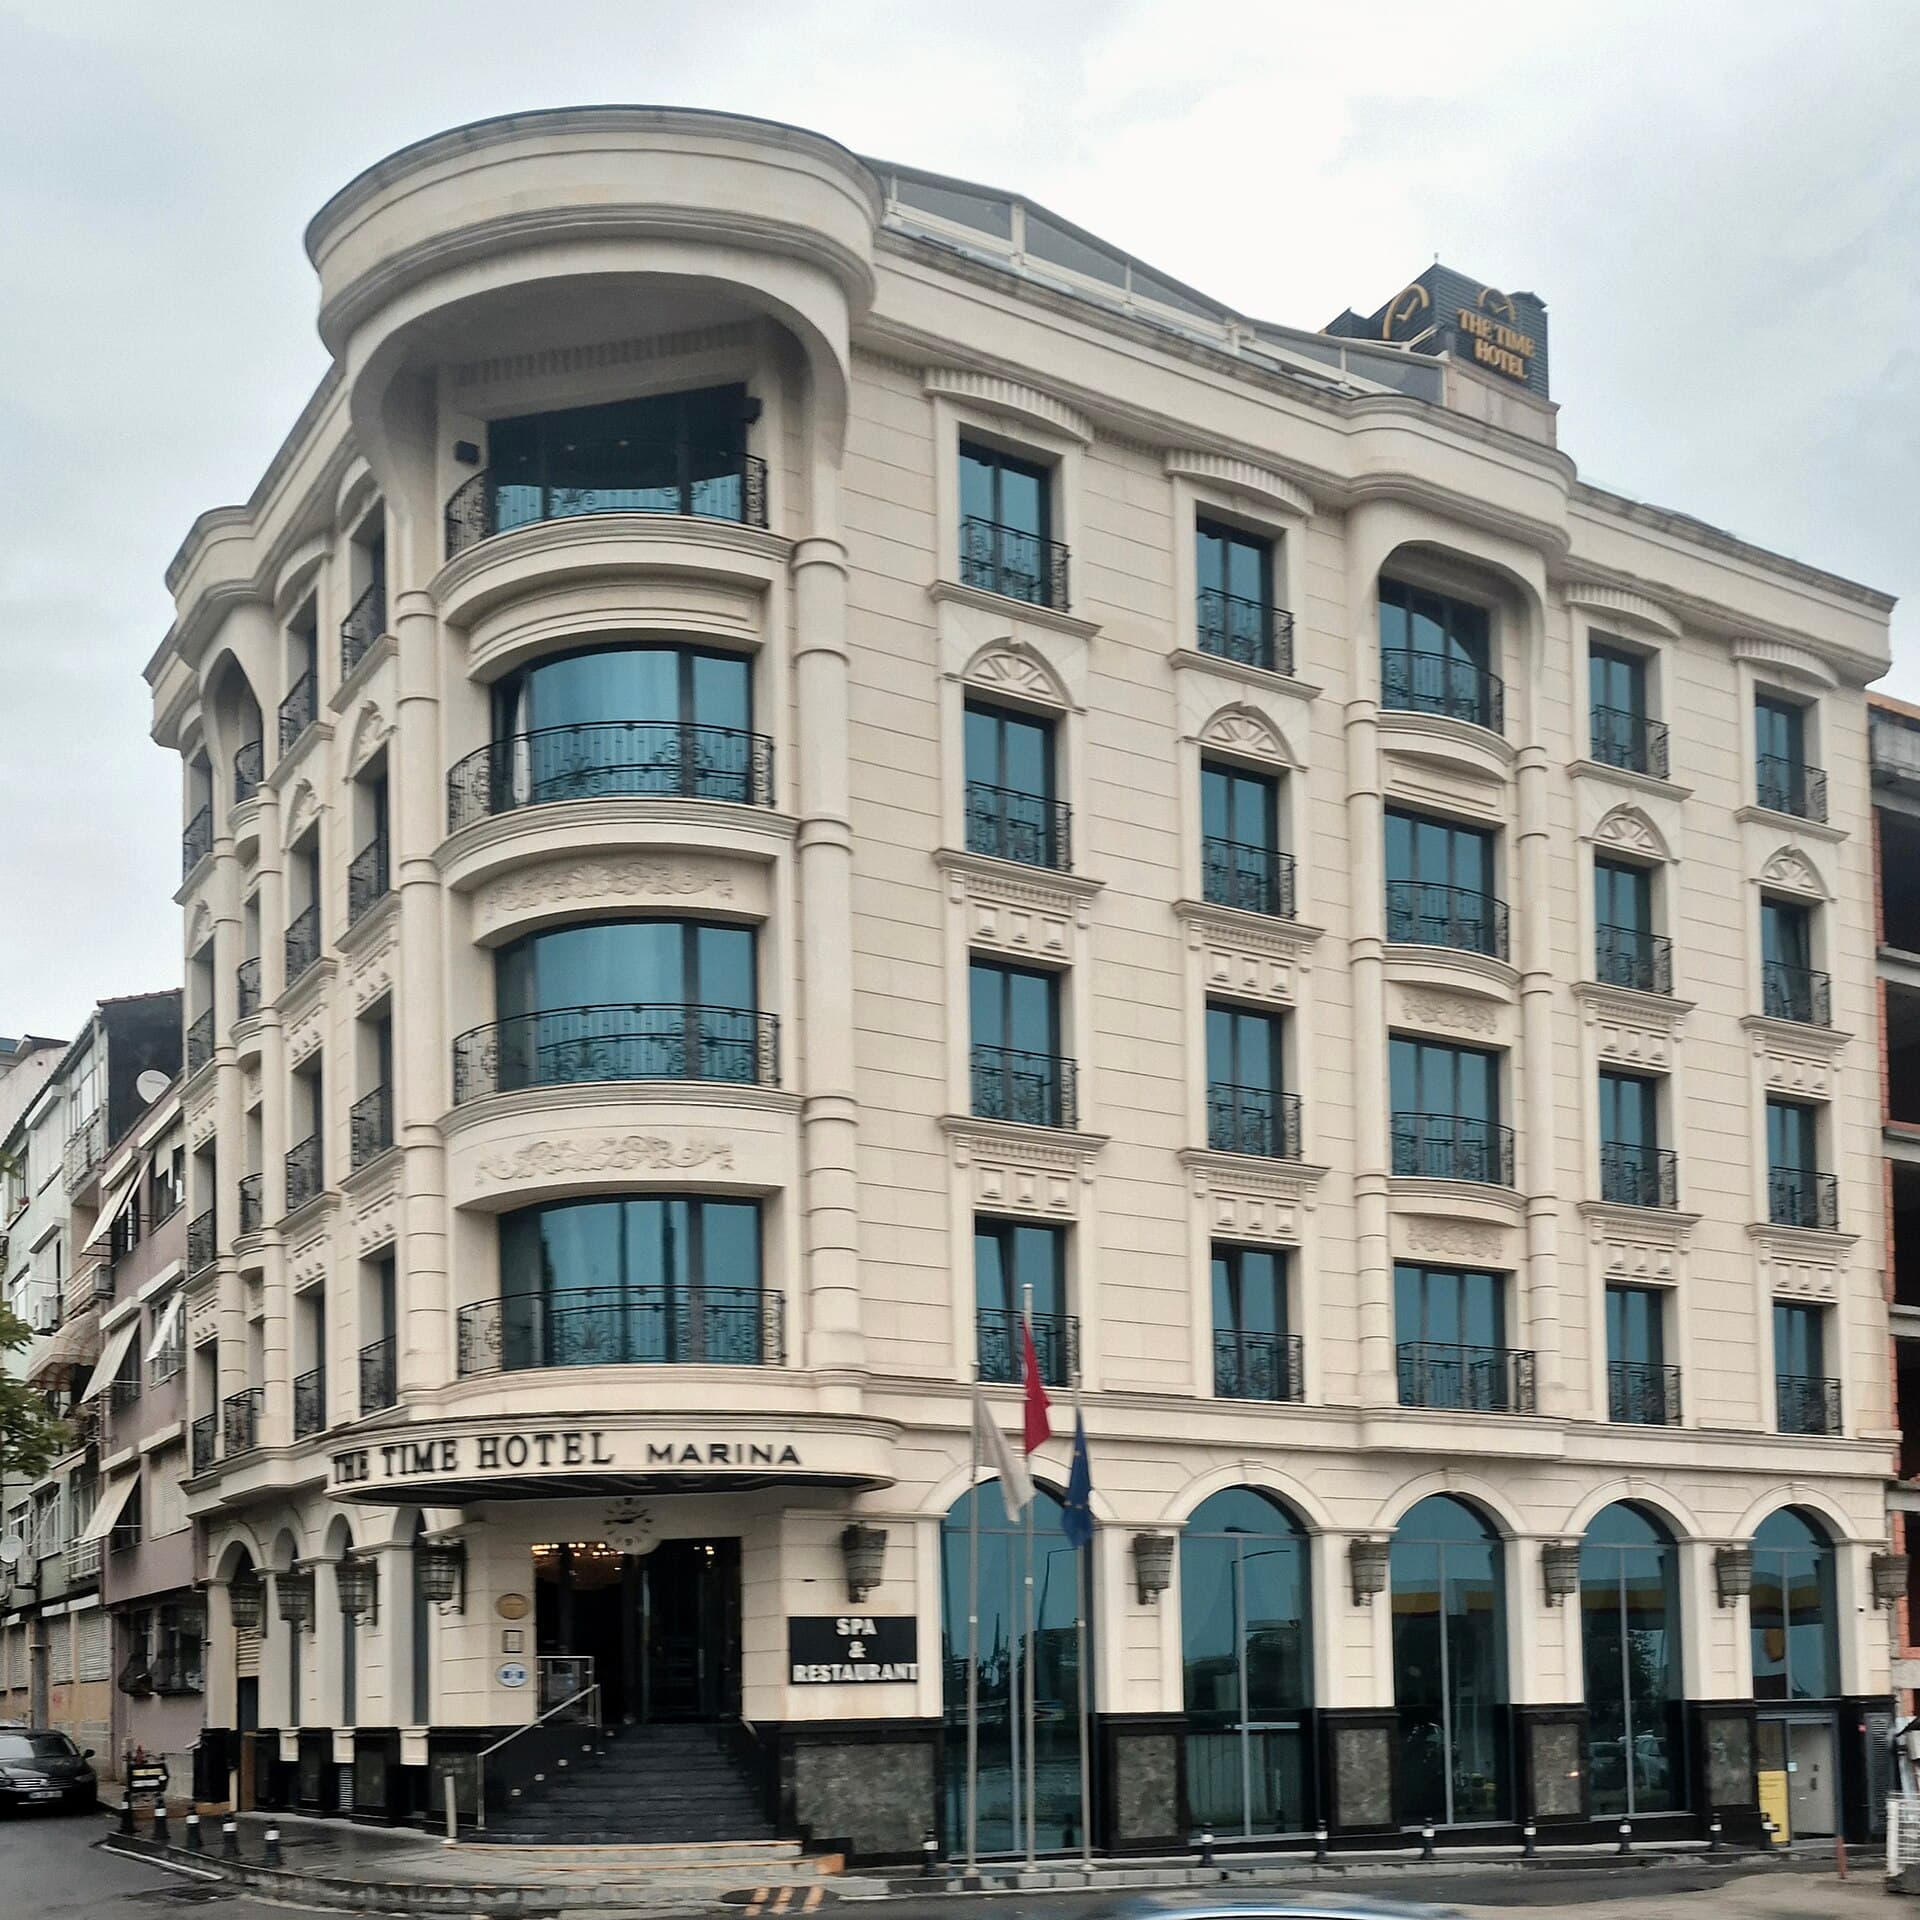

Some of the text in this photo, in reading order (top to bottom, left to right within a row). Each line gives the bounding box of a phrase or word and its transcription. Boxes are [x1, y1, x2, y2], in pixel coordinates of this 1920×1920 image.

[1456, 308, 1536, 358] THE TIME
[1475, 338, 1528, 379] HOTEL
[333, 1432, 801, 1484] THE TIME HOTEL MARINA
[836, 1618, 878, 1635] SPA
[848, 1641, 867, 1658] &
[793, 1663, 918, 1682] RESTAURANT
